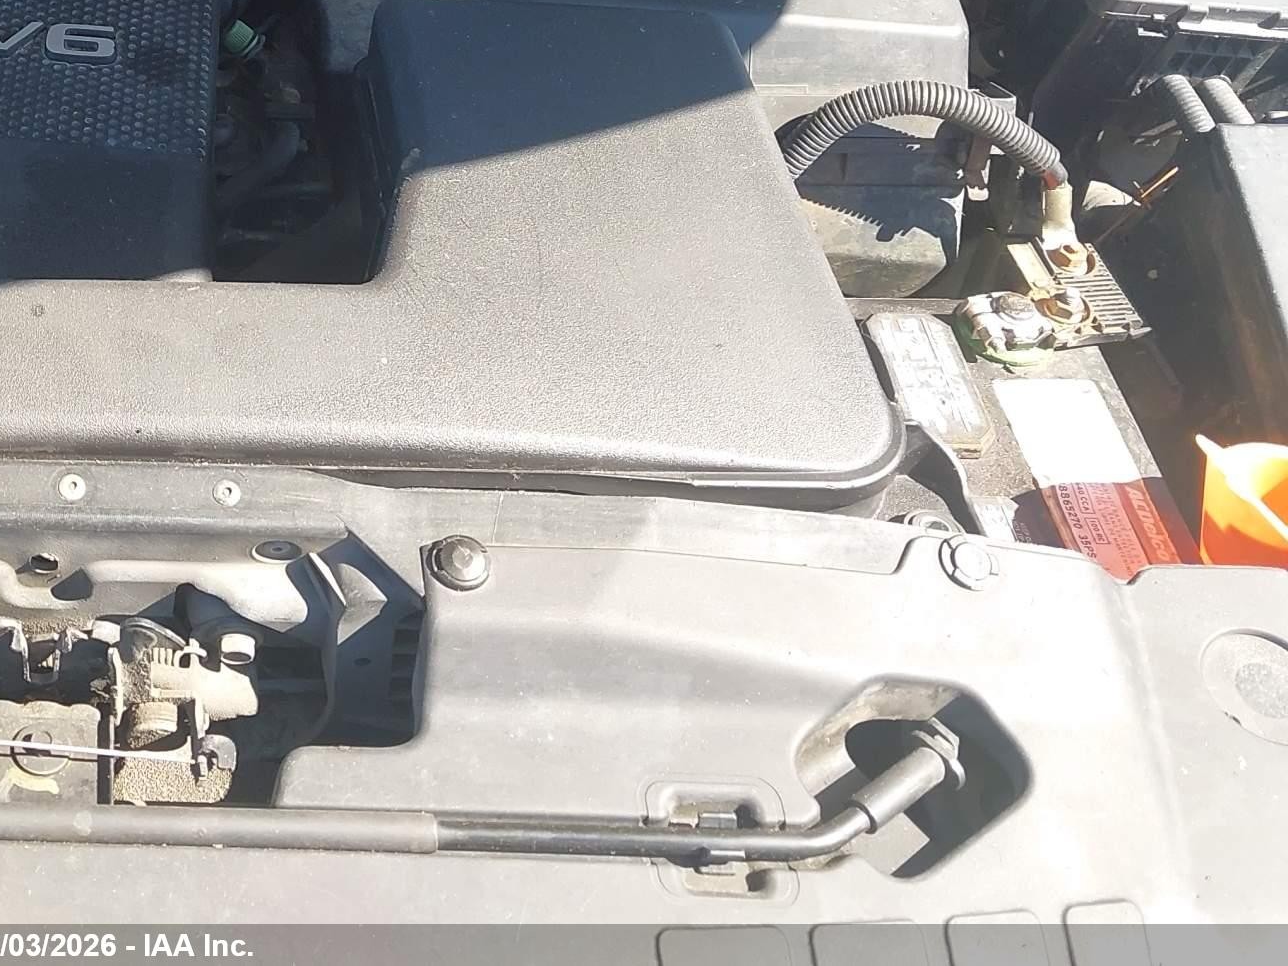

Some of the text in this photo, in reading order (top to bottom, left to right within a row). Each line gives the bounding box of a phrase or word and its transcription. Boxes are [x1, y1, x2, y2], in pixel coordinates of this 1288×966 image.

[1058, 483, 1097, 559] 8865270 35PS
[1080, 496, 1090, 511] CCA
[1090, 520, 1099, 532] 100
[1125, 486, 1170, 561] ACDelco
